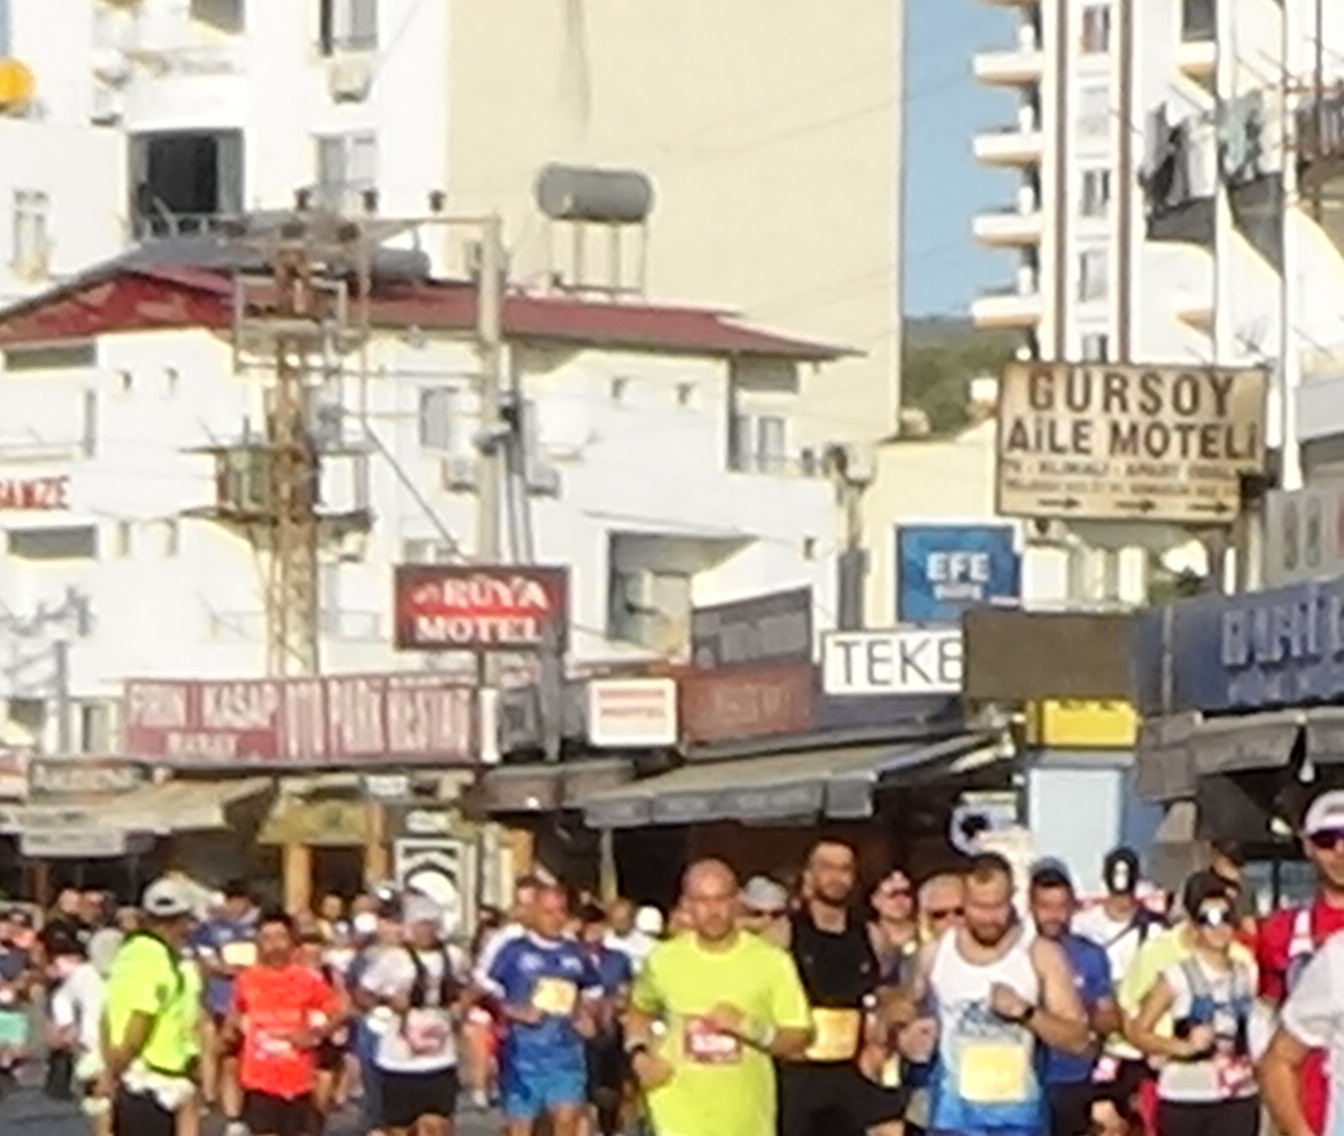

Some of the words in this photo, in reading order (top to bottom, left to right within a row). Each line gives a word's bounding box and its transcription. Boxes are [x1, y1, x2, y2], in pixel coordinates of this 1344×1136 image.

[926, 552, 990, 581] EFE
[414, 616, 543, 643] MOTEL
[834, 638, 963, 687] TEKE
[200, 681, 279, 729] KASAP
